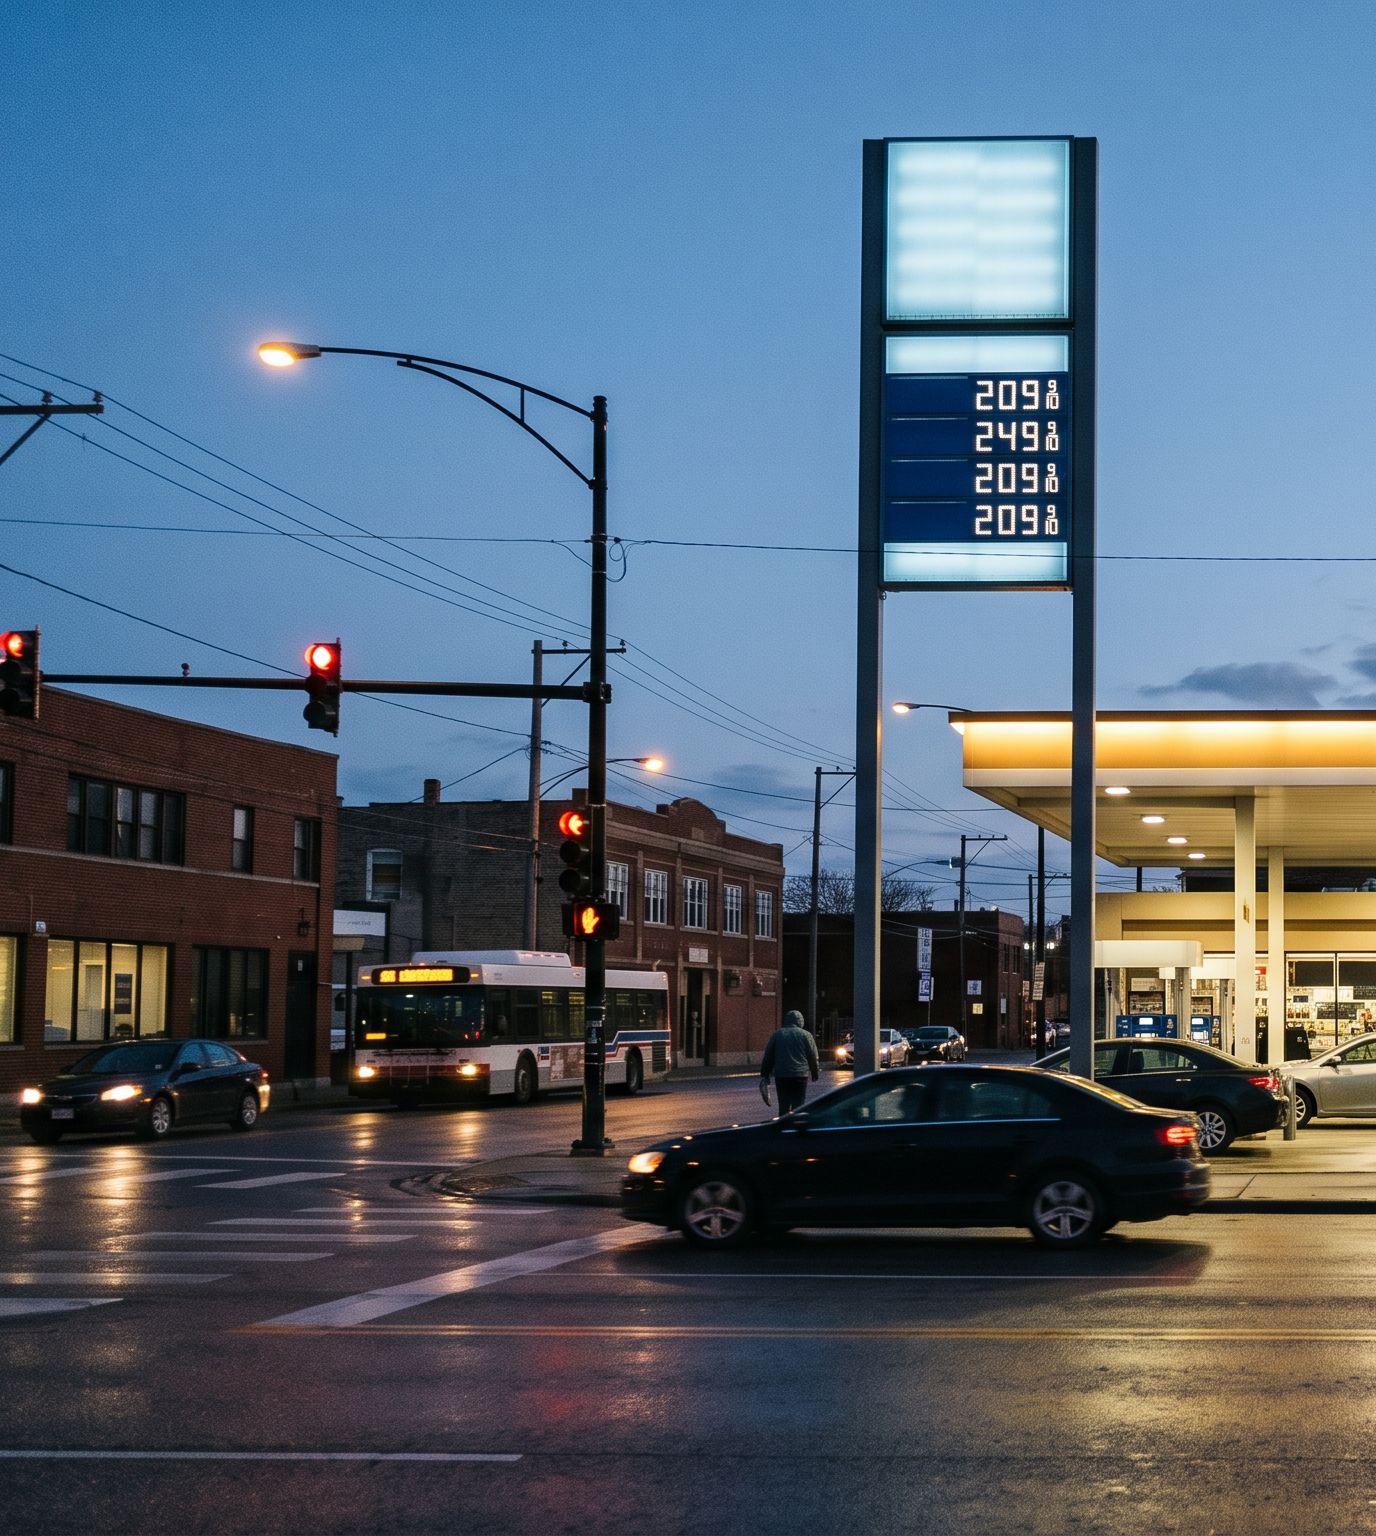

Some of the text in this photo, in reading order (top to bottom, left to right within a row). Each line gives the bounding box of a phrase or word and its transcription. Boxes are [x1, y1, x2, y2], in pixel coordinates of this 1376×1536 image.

[976, 380, 1039, 410] 209
[976, 421, 1039, 451] 249
[976, 463, 1038, 493] 209
[975, 505, 1038, 535] 209
